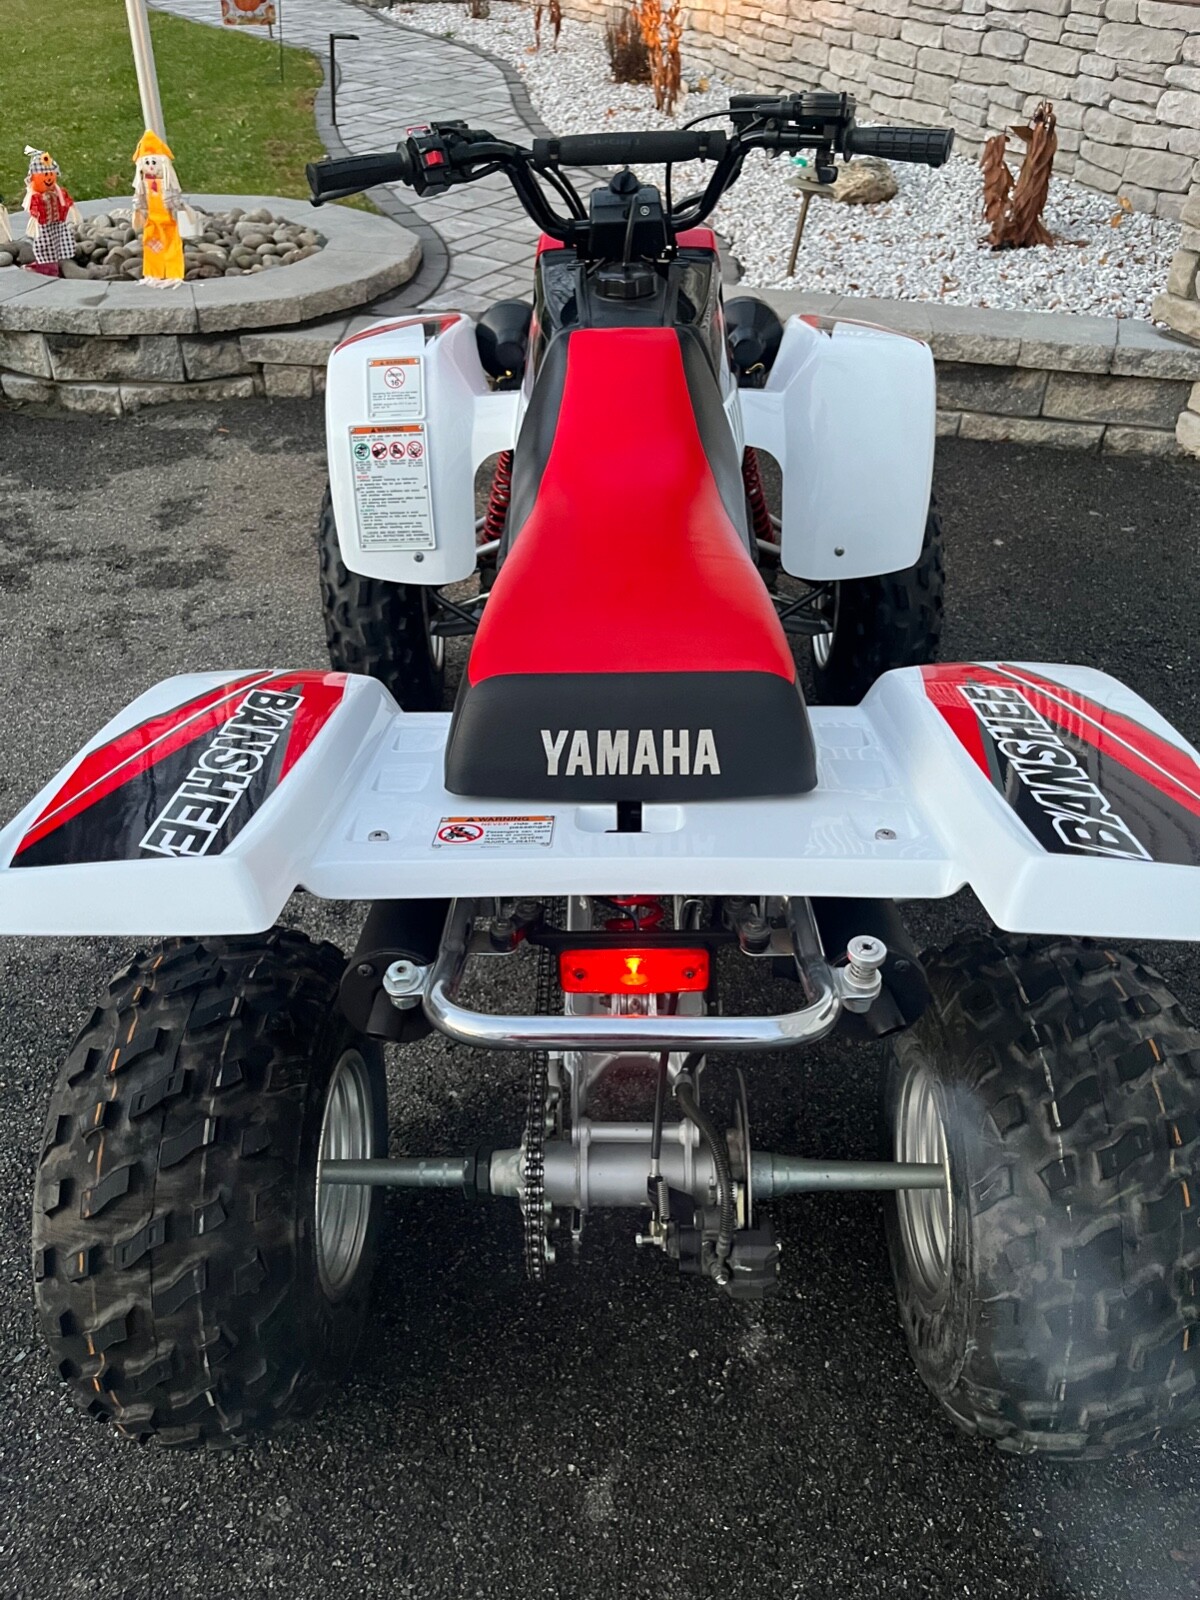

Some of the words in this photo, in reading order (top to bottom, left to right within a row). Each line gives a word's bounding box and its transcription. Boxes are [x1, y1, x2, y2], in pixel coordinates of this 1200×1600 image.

[139, 689, 305, 857] BANSHEE
[540, 729, 721, 776] YAMAHA
[957, 684, 1153, 861] BANSHEE
